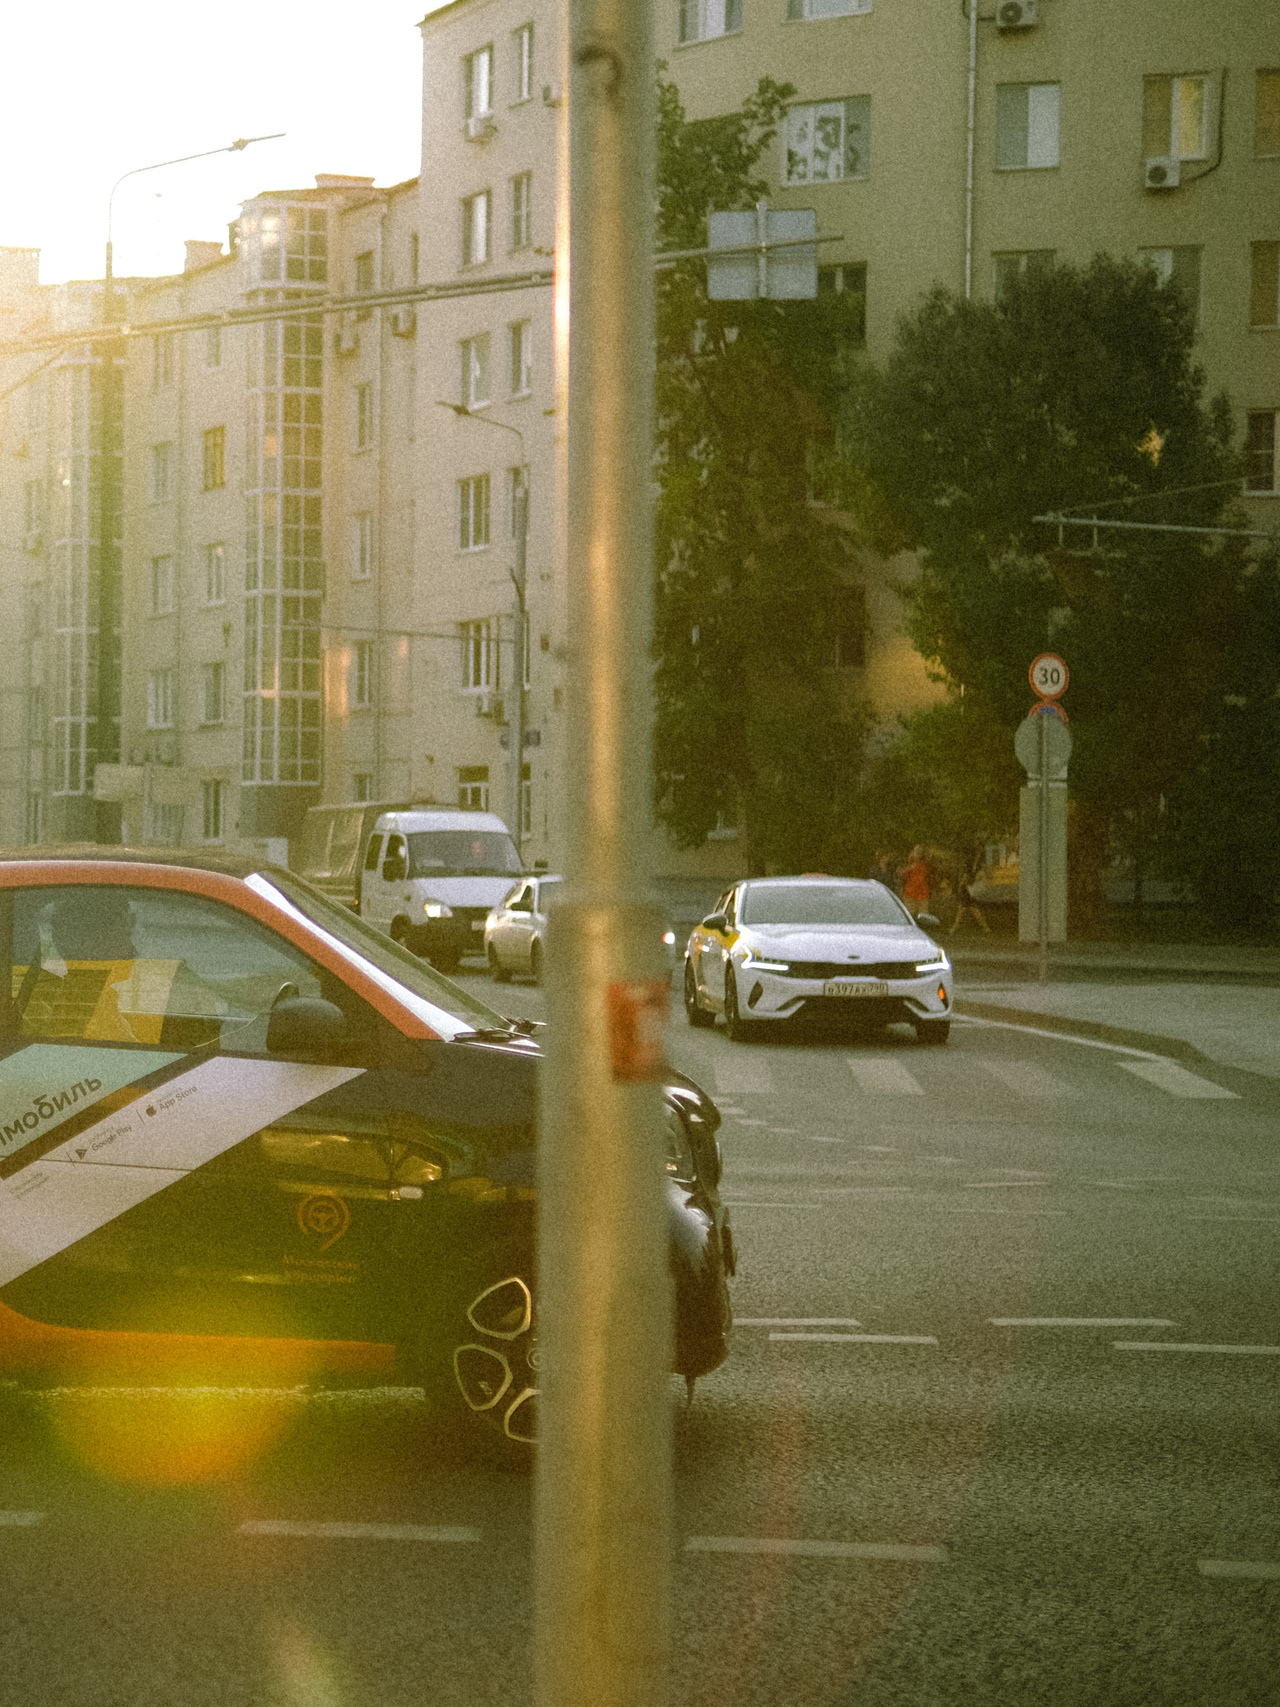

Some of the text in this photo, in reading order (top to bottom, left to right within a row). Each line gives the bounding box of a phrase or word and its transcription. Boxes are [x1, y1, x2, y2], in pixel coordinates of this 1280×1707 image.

[1039, 668, 1060, 685] 30
[159, 1099, 176, 1111] App
[176, 1086, 198, 1101] Store
[91, 1133, 117, 1152] Google
[116, 1125, 132, 1137] Play
